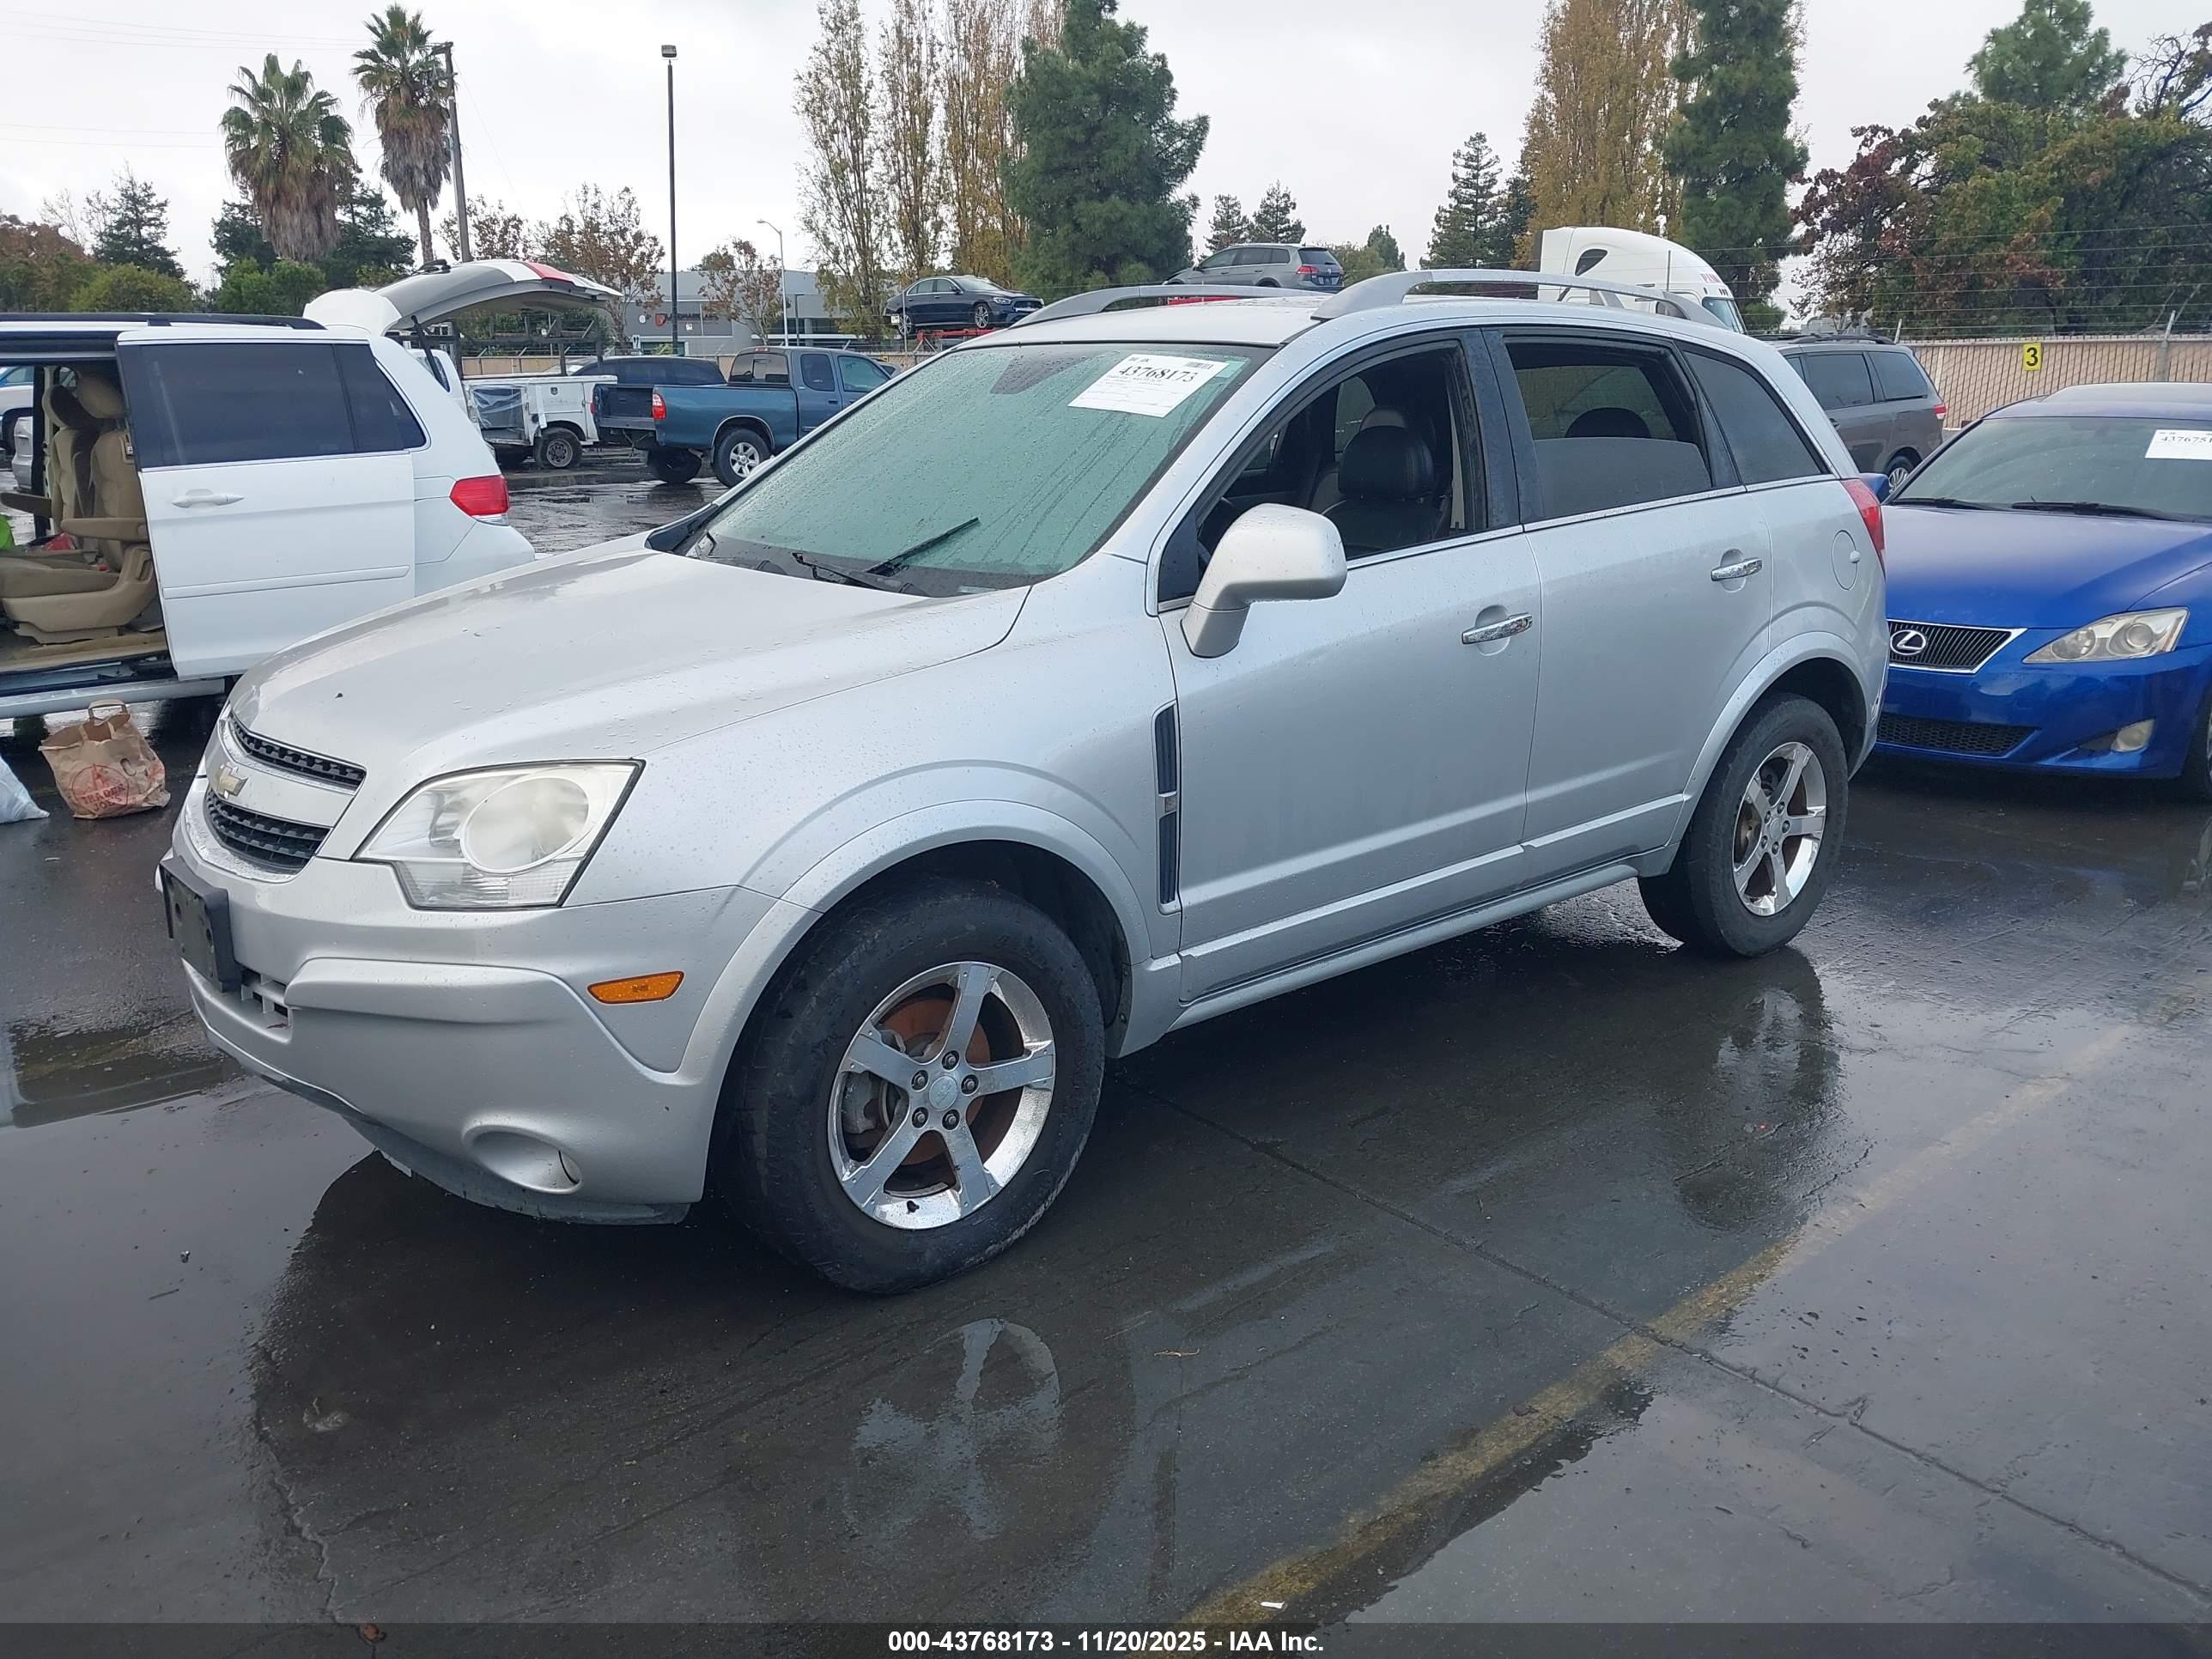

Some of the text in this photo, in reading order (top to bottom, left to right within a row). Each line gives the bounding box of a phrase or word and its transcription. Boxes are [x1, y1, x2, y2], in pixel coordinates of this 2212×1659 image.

[2026, 347, 2039, 367] 3
[1119, 365, 1199, 382] 43768173
[81, 782, 125, 805] TRADER
